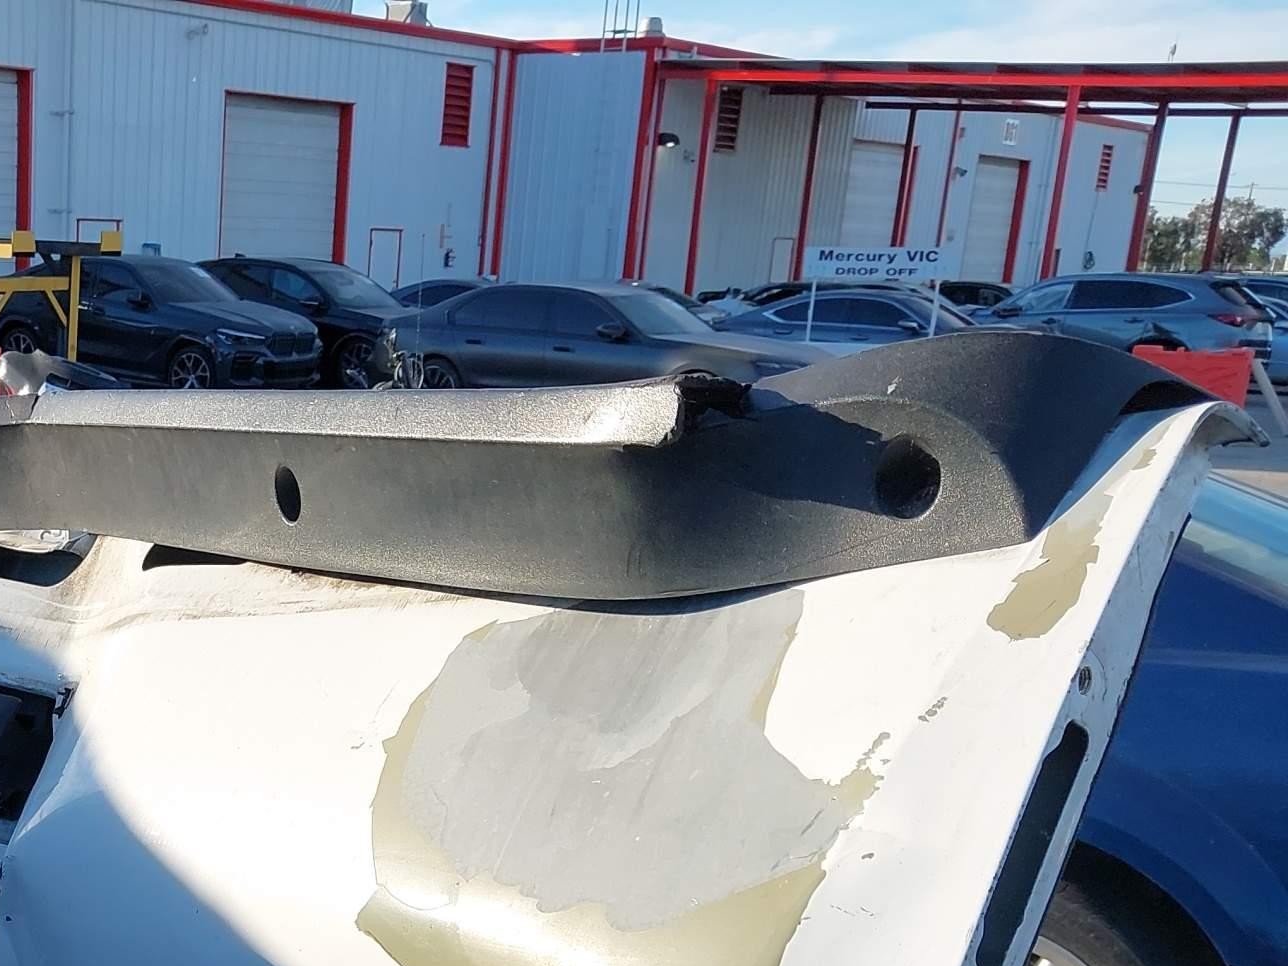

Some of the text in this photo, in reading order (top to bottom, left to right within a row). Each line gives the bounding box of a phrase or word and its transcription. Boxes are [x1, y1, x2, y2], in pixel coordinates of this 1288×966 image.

[818, 250, 939, 264] Mercury VIC
[834, 267, 919, 277] DROP OFF
